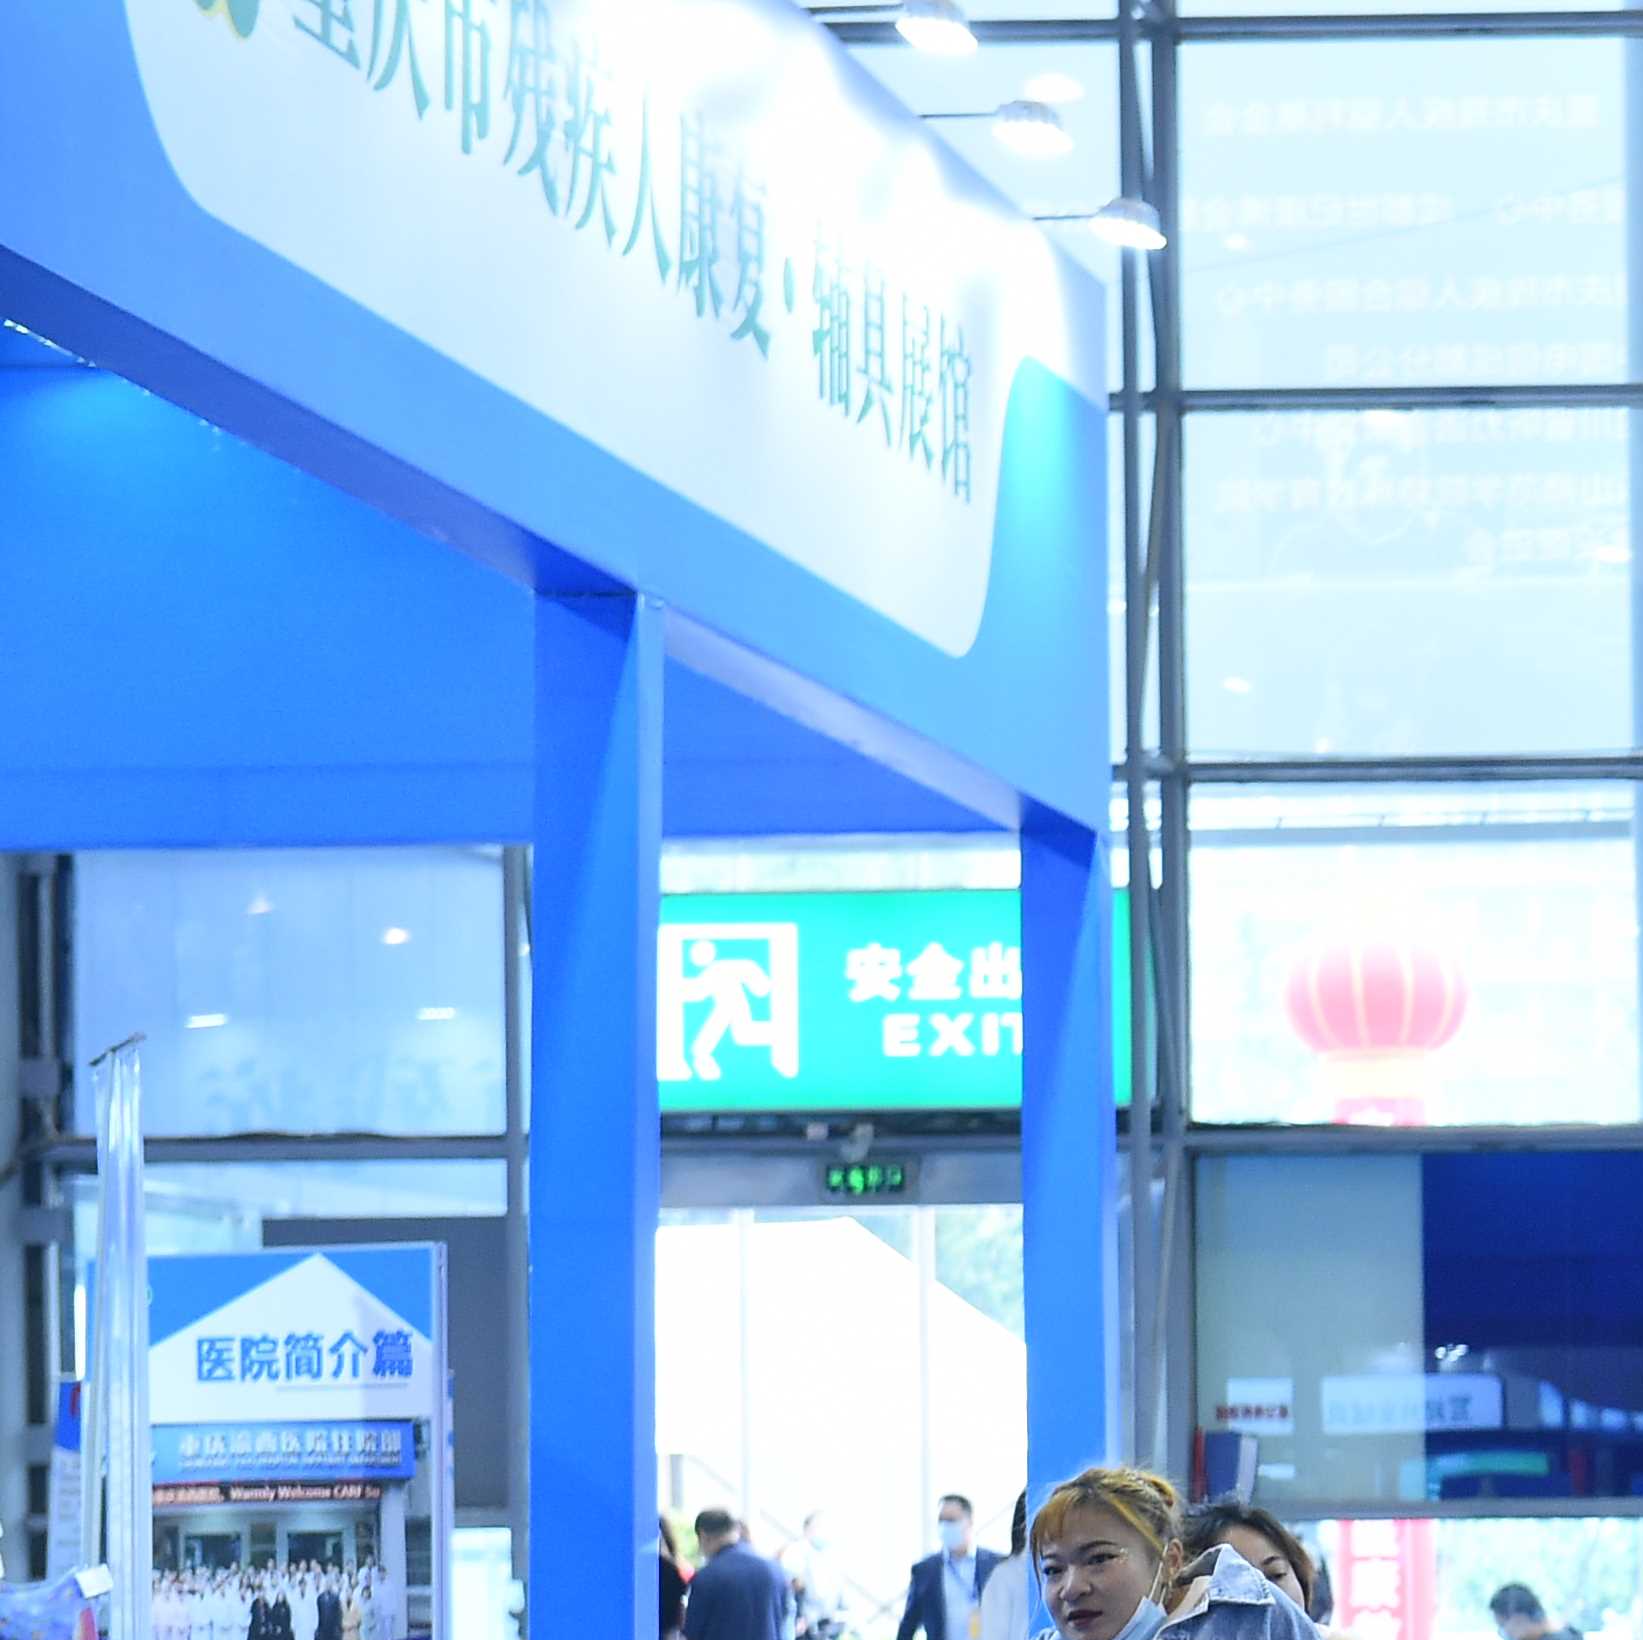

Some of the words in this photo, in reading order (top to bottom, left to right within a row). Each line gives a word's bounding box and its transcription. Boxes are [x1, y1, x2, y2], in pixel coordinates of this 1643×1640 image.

[196, 1329, 414, 1382] 医院简介篇
